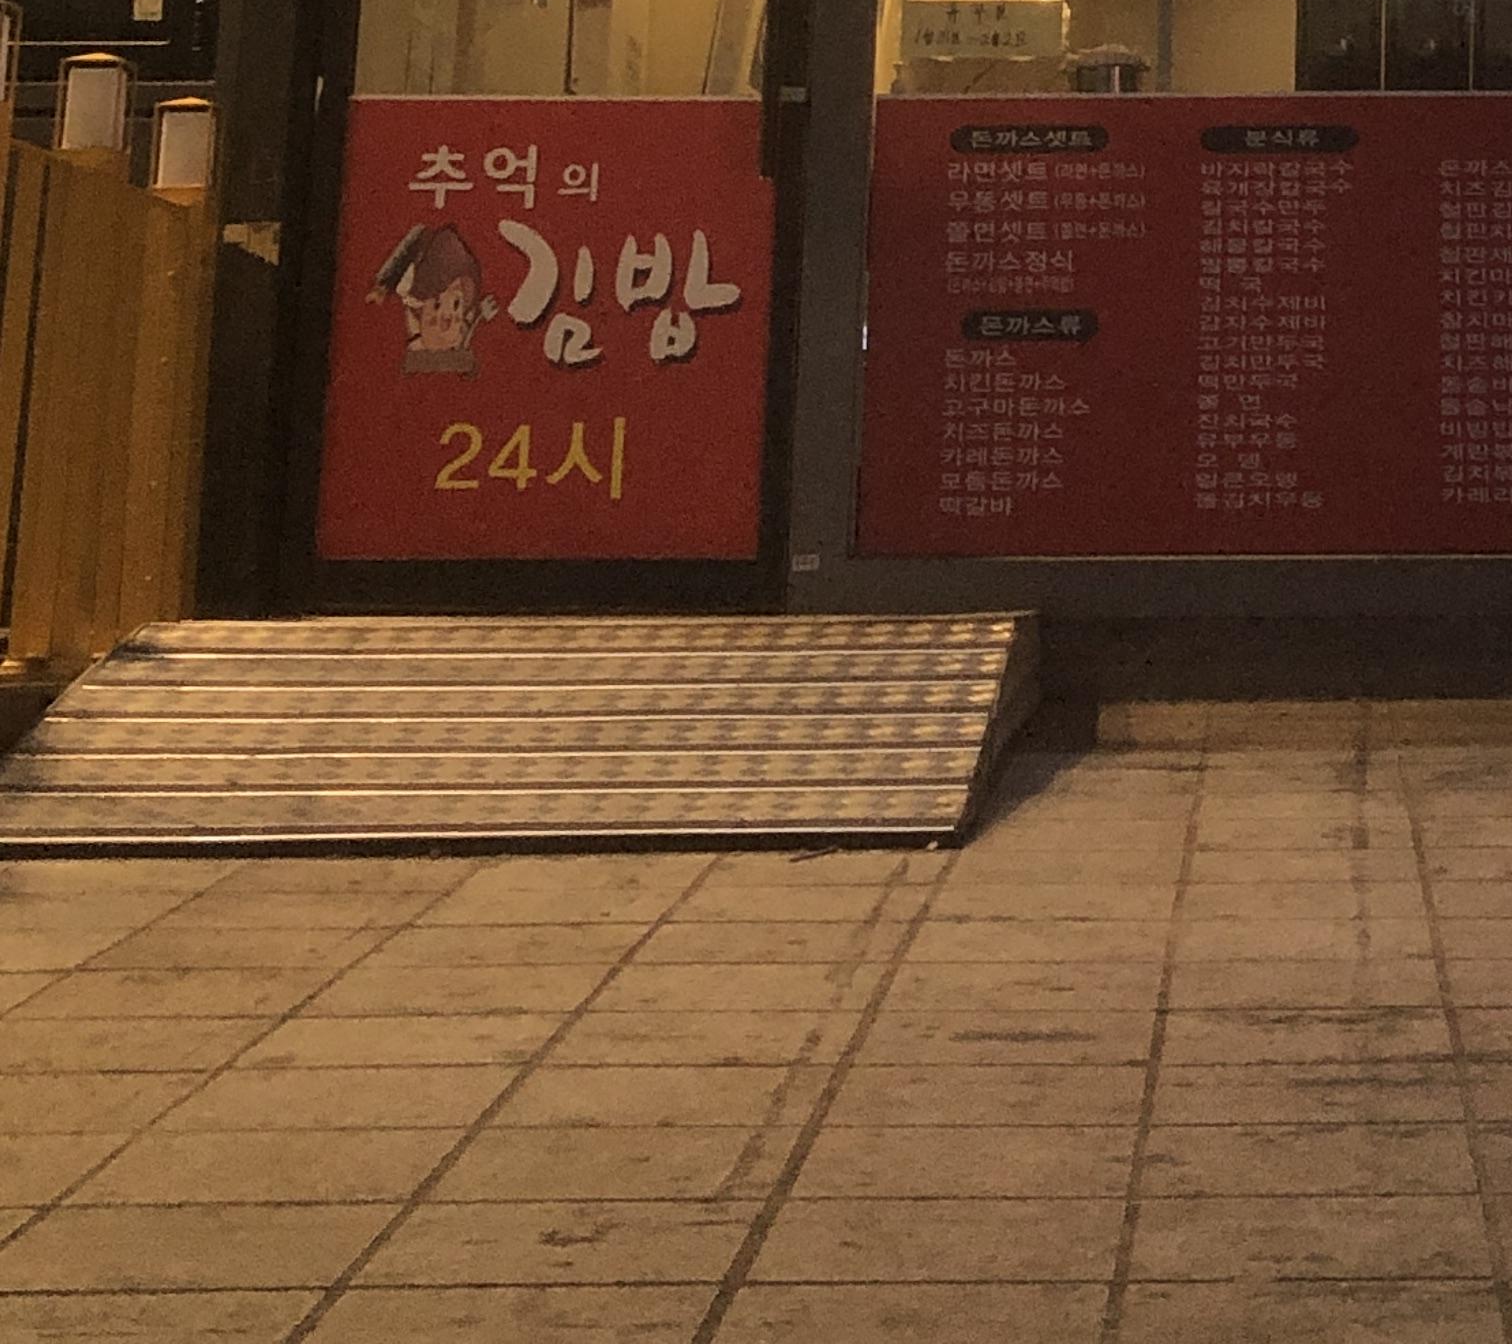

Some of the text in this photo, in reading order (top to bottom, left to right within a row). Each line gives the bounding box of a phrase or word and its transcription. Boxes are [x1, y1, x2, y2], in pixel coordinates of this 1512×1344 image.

[408, 144, 599, 209] 추억의
[948, 160, 1048, 183] 라면셋트
[945, 249, 1074, 273] 돈까스정식
[499, 219, 741, 365] 김밥
[944, 348, 1018, 368] 돈까스
[942, 397, 1091, 417] 고구마돈까스
[435, 416, 626, 500] 24시
